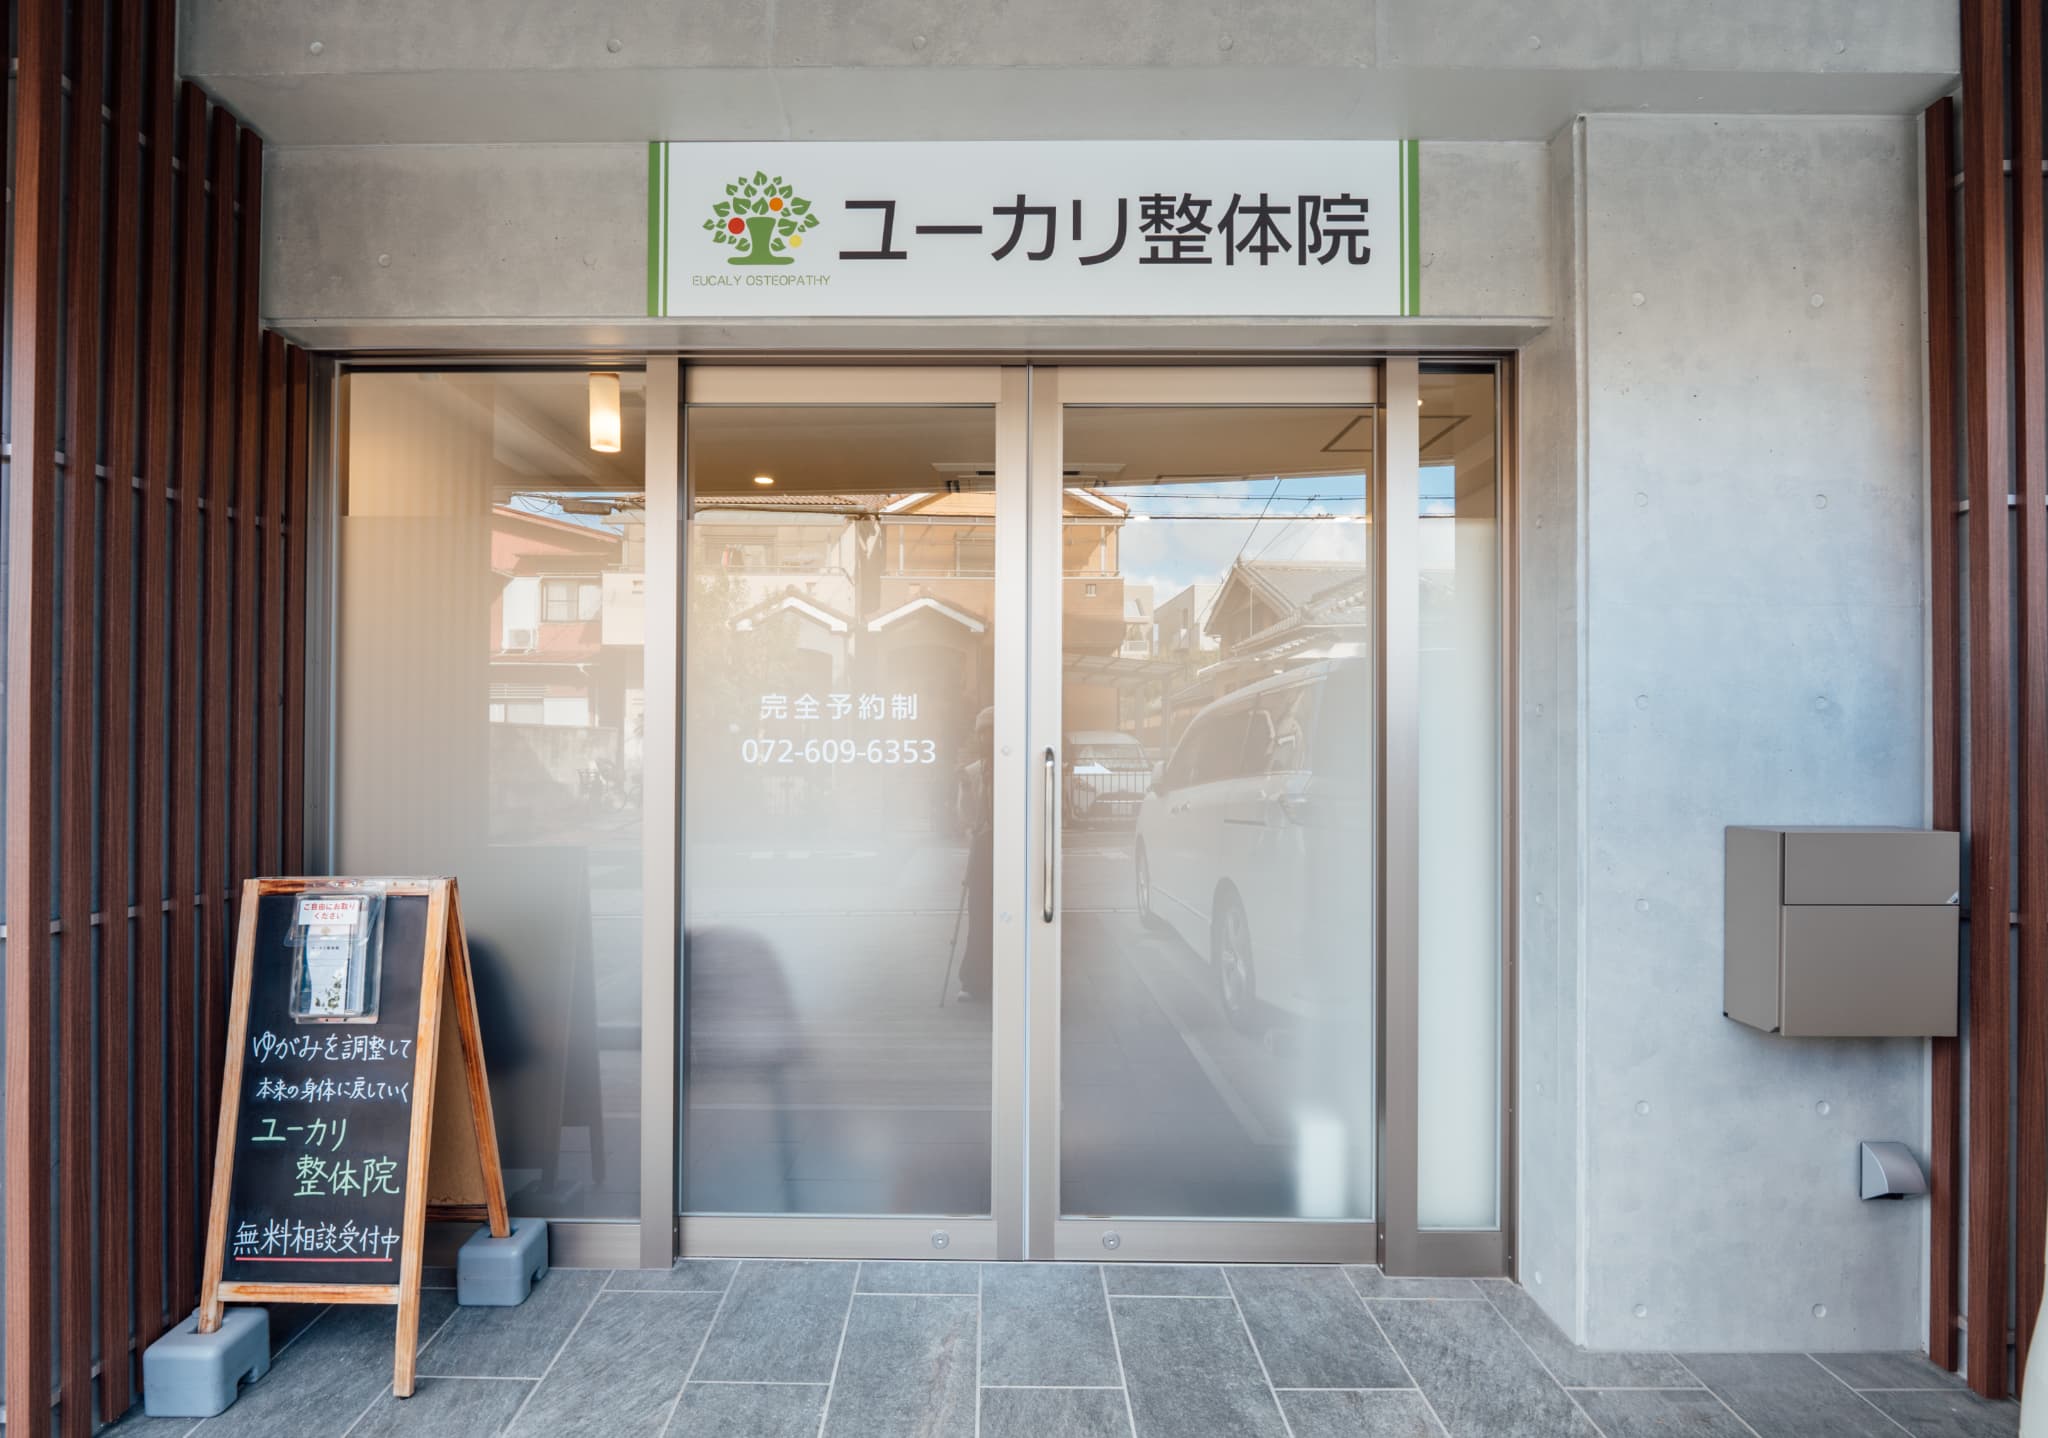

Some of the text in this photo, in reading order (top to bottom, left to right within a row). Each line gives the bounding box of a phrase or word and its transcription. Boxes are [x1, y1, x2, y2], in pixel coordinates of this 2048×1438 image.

[838, 192, 1372, 267] ユーカリ整体院
[692, 275, 831, 286] EUCALY OSTEOPATHY
[759, 693, 918, 721] 完全予約制
[741, 739, 937, 764] 072-609-6353
[314, 912, 344, 920] ください
[252, 1030, 413, 1063] ゆがみを調整して
[256, 1076, 409, 1103] 本来の身体に戻していく
[251, 1117, 347, 1152] ユーカリ
[293, 1153, 400, 1198] 整体院
[232, 1218, 401, 1259] 無料相談受付中
